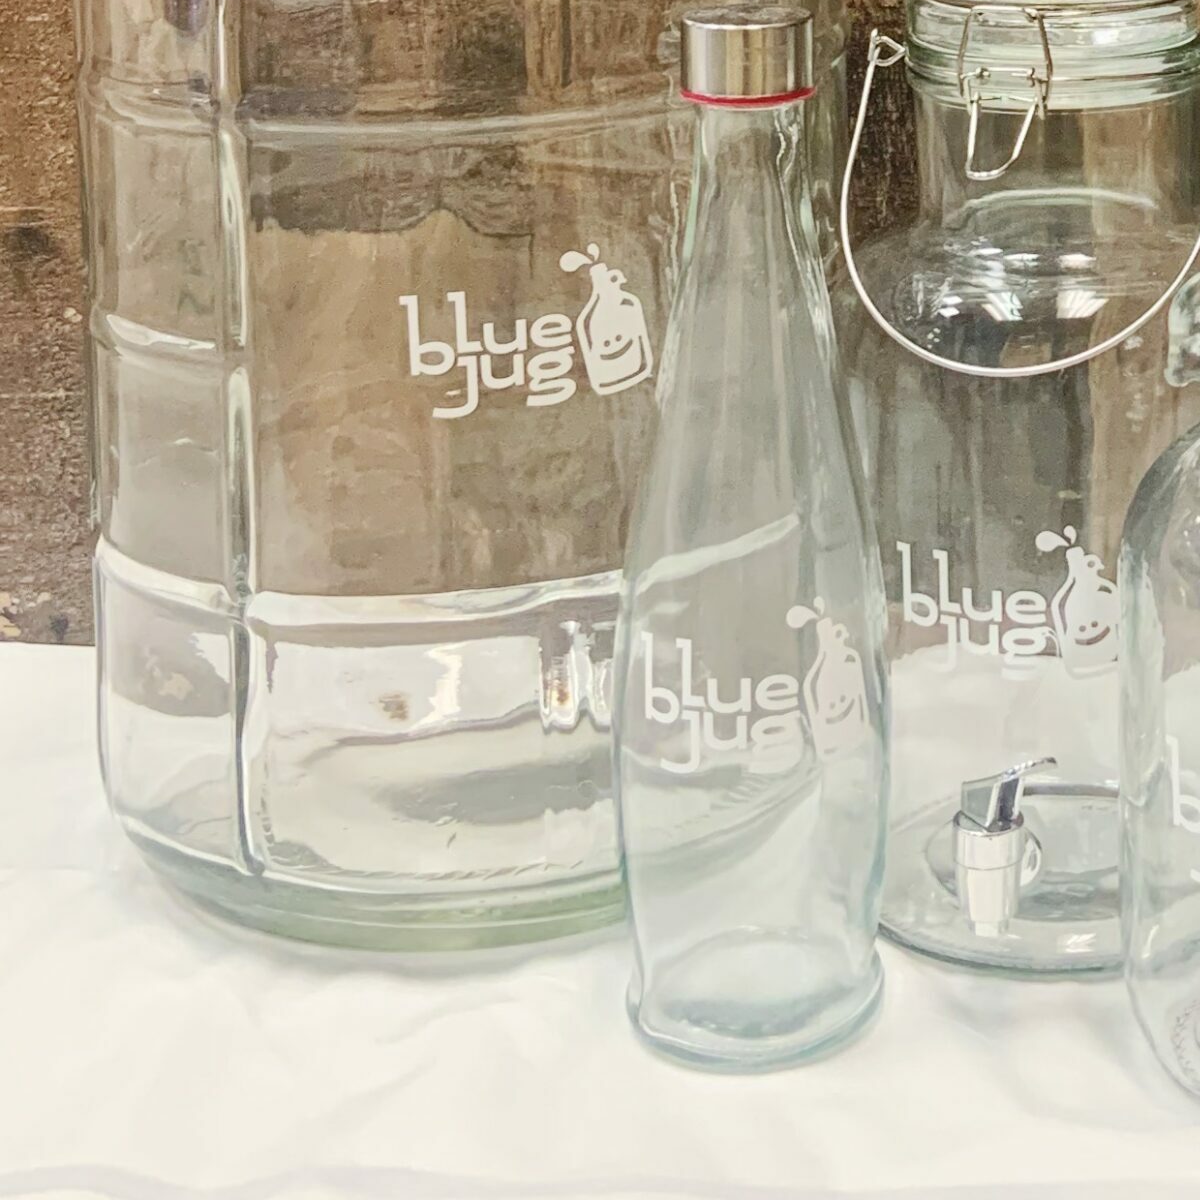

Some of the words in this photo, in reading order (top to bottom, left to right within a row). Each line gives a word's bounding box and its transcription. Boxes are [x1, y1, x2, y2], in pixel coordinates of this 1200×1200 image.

[399, 291, 573, 376] blue
[432, 346, 577, 419] jug
[896, 541, 1047, 627] blue
[641, 631, 799, 724] blue
[928, 614, 1049, 680] jug
[660, 709, 802, 774] jug
